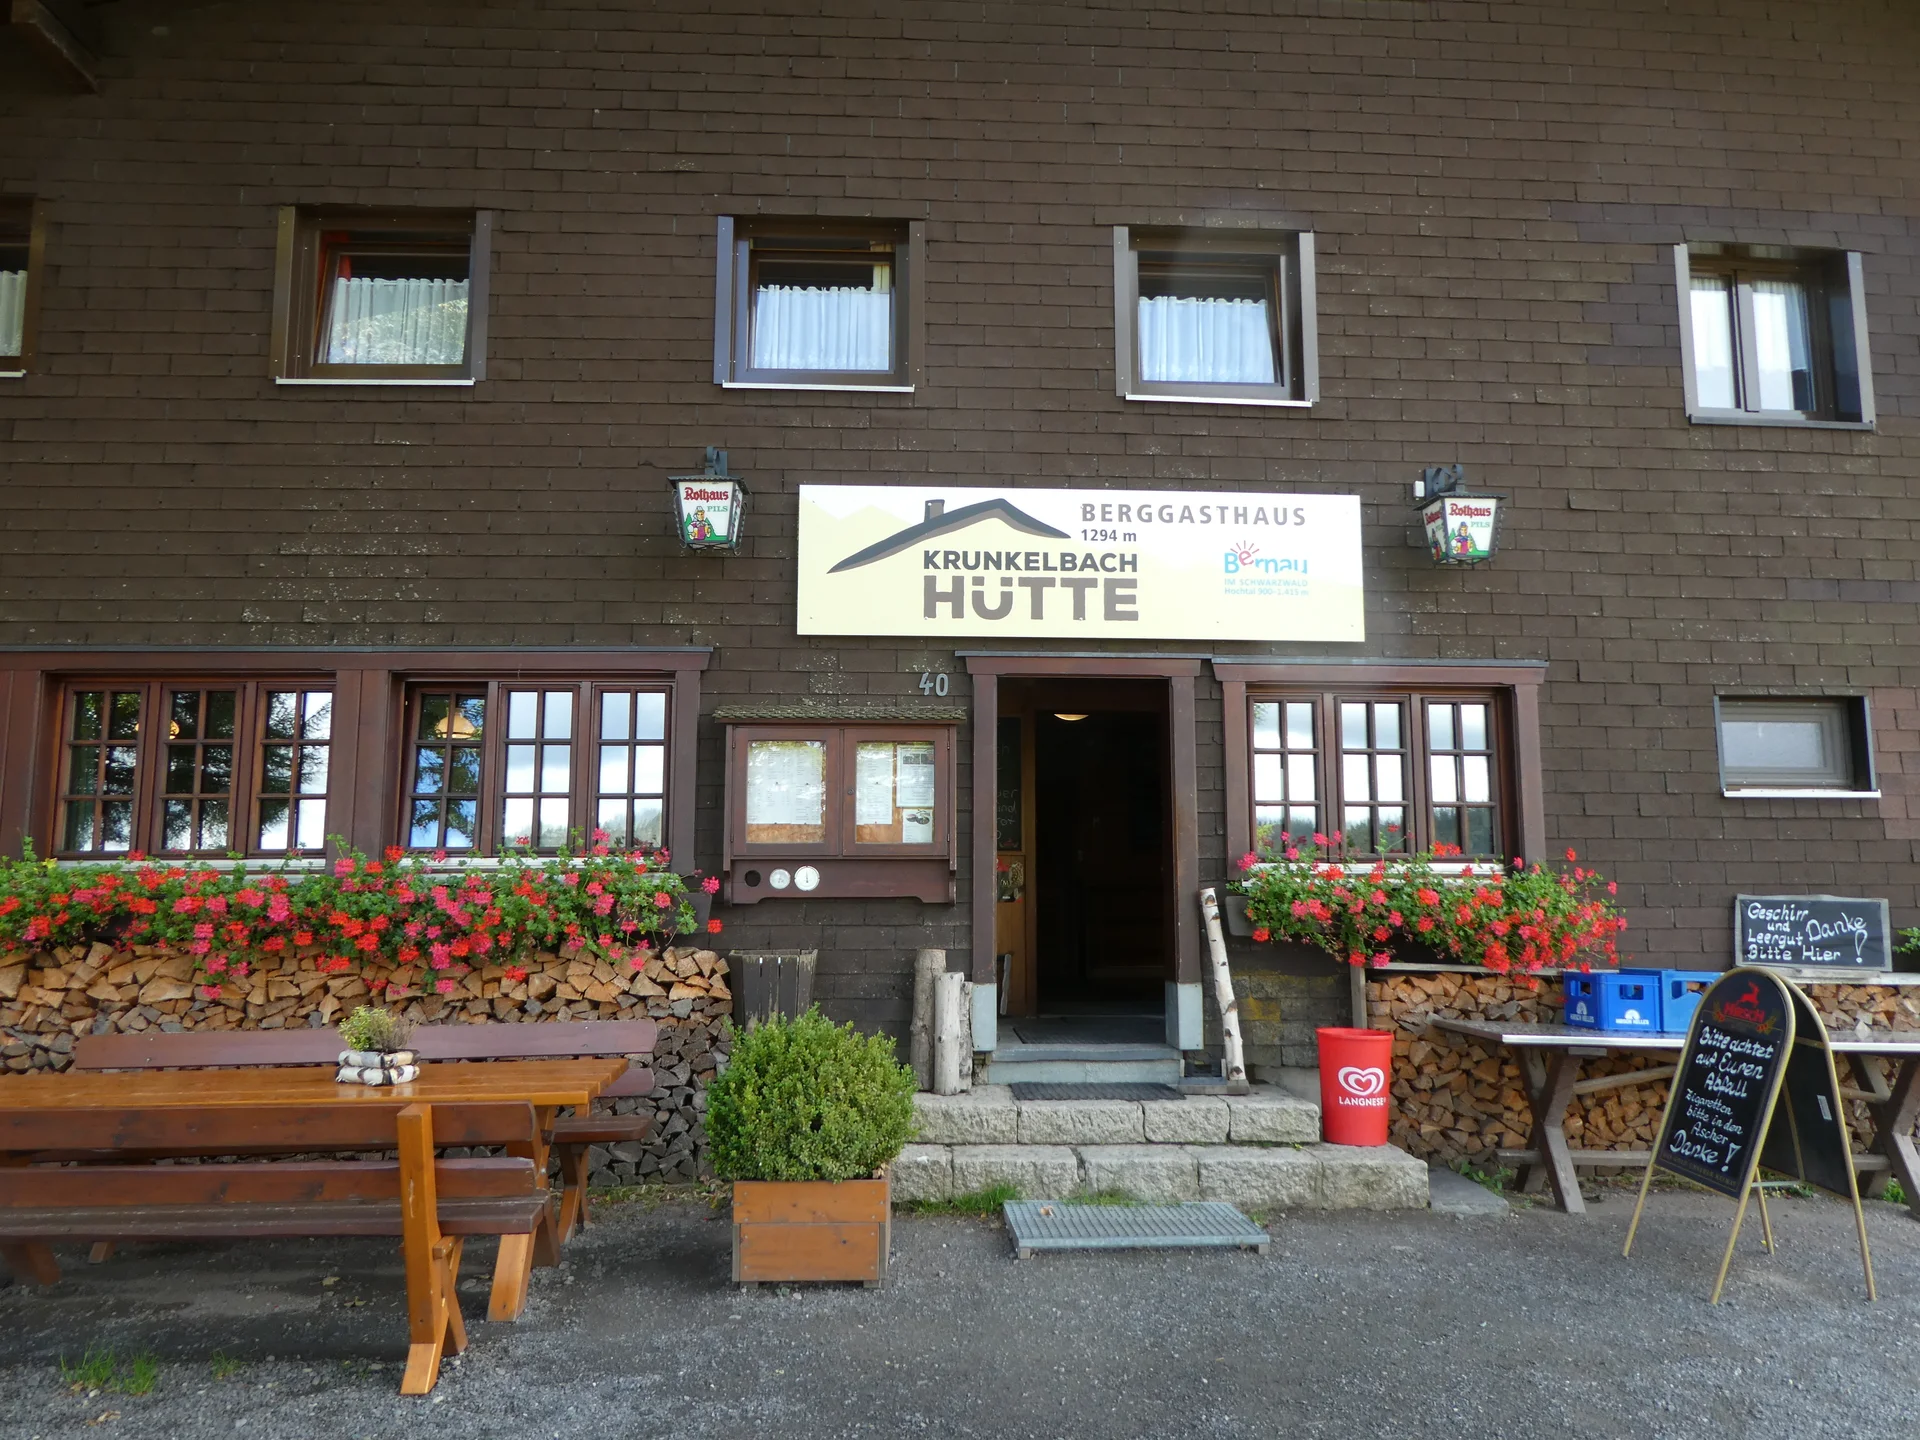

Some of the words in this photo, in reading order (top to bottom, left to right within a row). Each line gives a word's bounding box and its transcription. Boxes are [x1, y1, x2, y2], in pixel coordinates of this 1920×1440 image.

[684, 487, 729, 502] Rothaus
[1081, 503, 1307, 526] BERGGASTHAUS
[1448, 503, 1491, 518] Rothaus
[1081, 528, 1118, 543] 1294
[1123, 531, 1138, 543] m
[923, 549, 1138, 573] KRUNKELBACH
[1224, 550, 1308, 574] Bernau
[1239, 578, 1308, 587] SCHWARZWALD
[923, 574, 1139, 622] HÜTTE
[919, 672, 949, 697] 40
[1747, 902, 1809, 921] Geschirr
[1767, 921, 1791, 932] und
[1806, 912, 1868, 942] Danke
[1747, 929, 1804, 949] Leergut
[1747, 944, 1793, 961] Bitte
[1802, 945, 1841, 962] Hier
[1699, 1026, 1731, 1049] Bitte
[1730, 1039, 1774, 1059] achtet
[1695, 1051, 1718, 1067] auf
[1718, 1052, 1764, 1079] Euren
[1703, 1072, 1747, 1098] Abfall
[1338, 1096, 1384, 1106] LANGNESE
[1684, 1088, 1733, 1115] Zigaretten
[1686, 1104, 1709, 1121] bitte
[1711, 1115, 1723, 1127] in
[1723, 1118, 1743, 1135] den
[1690, 1121, 1729, 1145] Ascher
[1669, 1129, 1719, 1163] Danke
